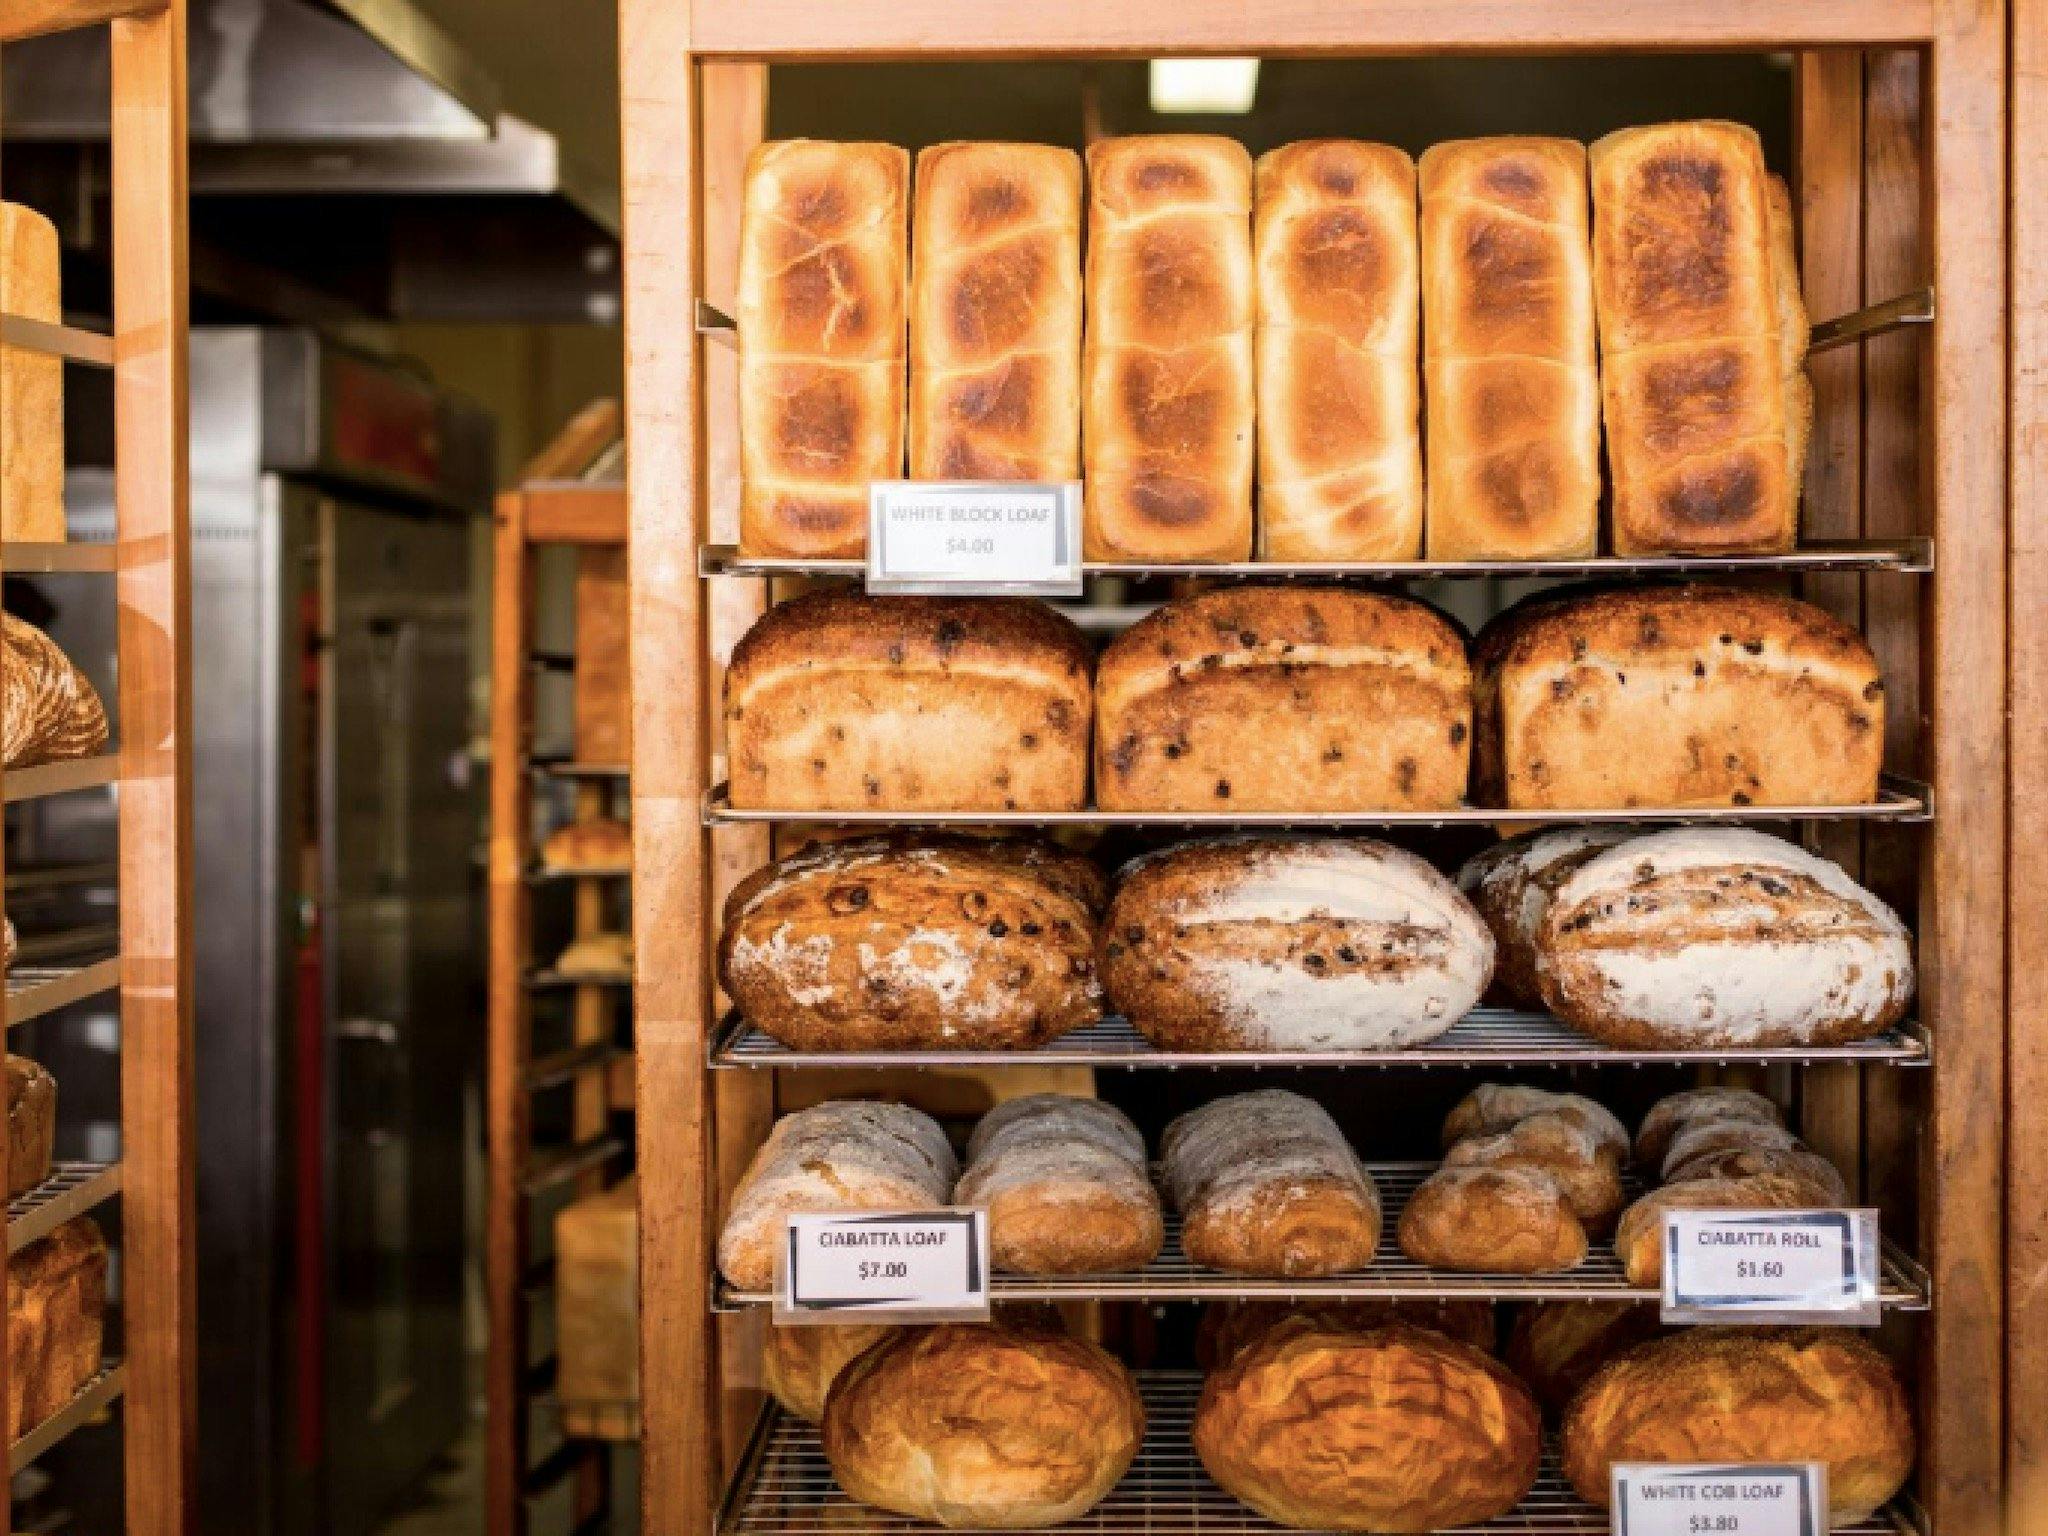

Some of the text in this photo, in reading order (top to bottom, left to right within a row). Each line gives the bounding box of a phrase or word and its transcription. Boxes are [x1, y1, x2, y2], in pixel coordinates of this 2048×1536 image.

[891, 505, 1050, 522] WHITE BLOCK LOAF
[946, 537, 994, 554] $4.00
[819, 1231, 948, 1247] CIABATTA LOAF
[1697, 1231, 1822, 1248] CIABATTA ROLL
[858, 1261, 907, 1280] $7.00
[1736, 1259, 1783, 1278] $1.60
[1641, 1484, 1784, 1500] WHITE COB LOAF
[1689, 1514, 1739, 1533] $3.80
